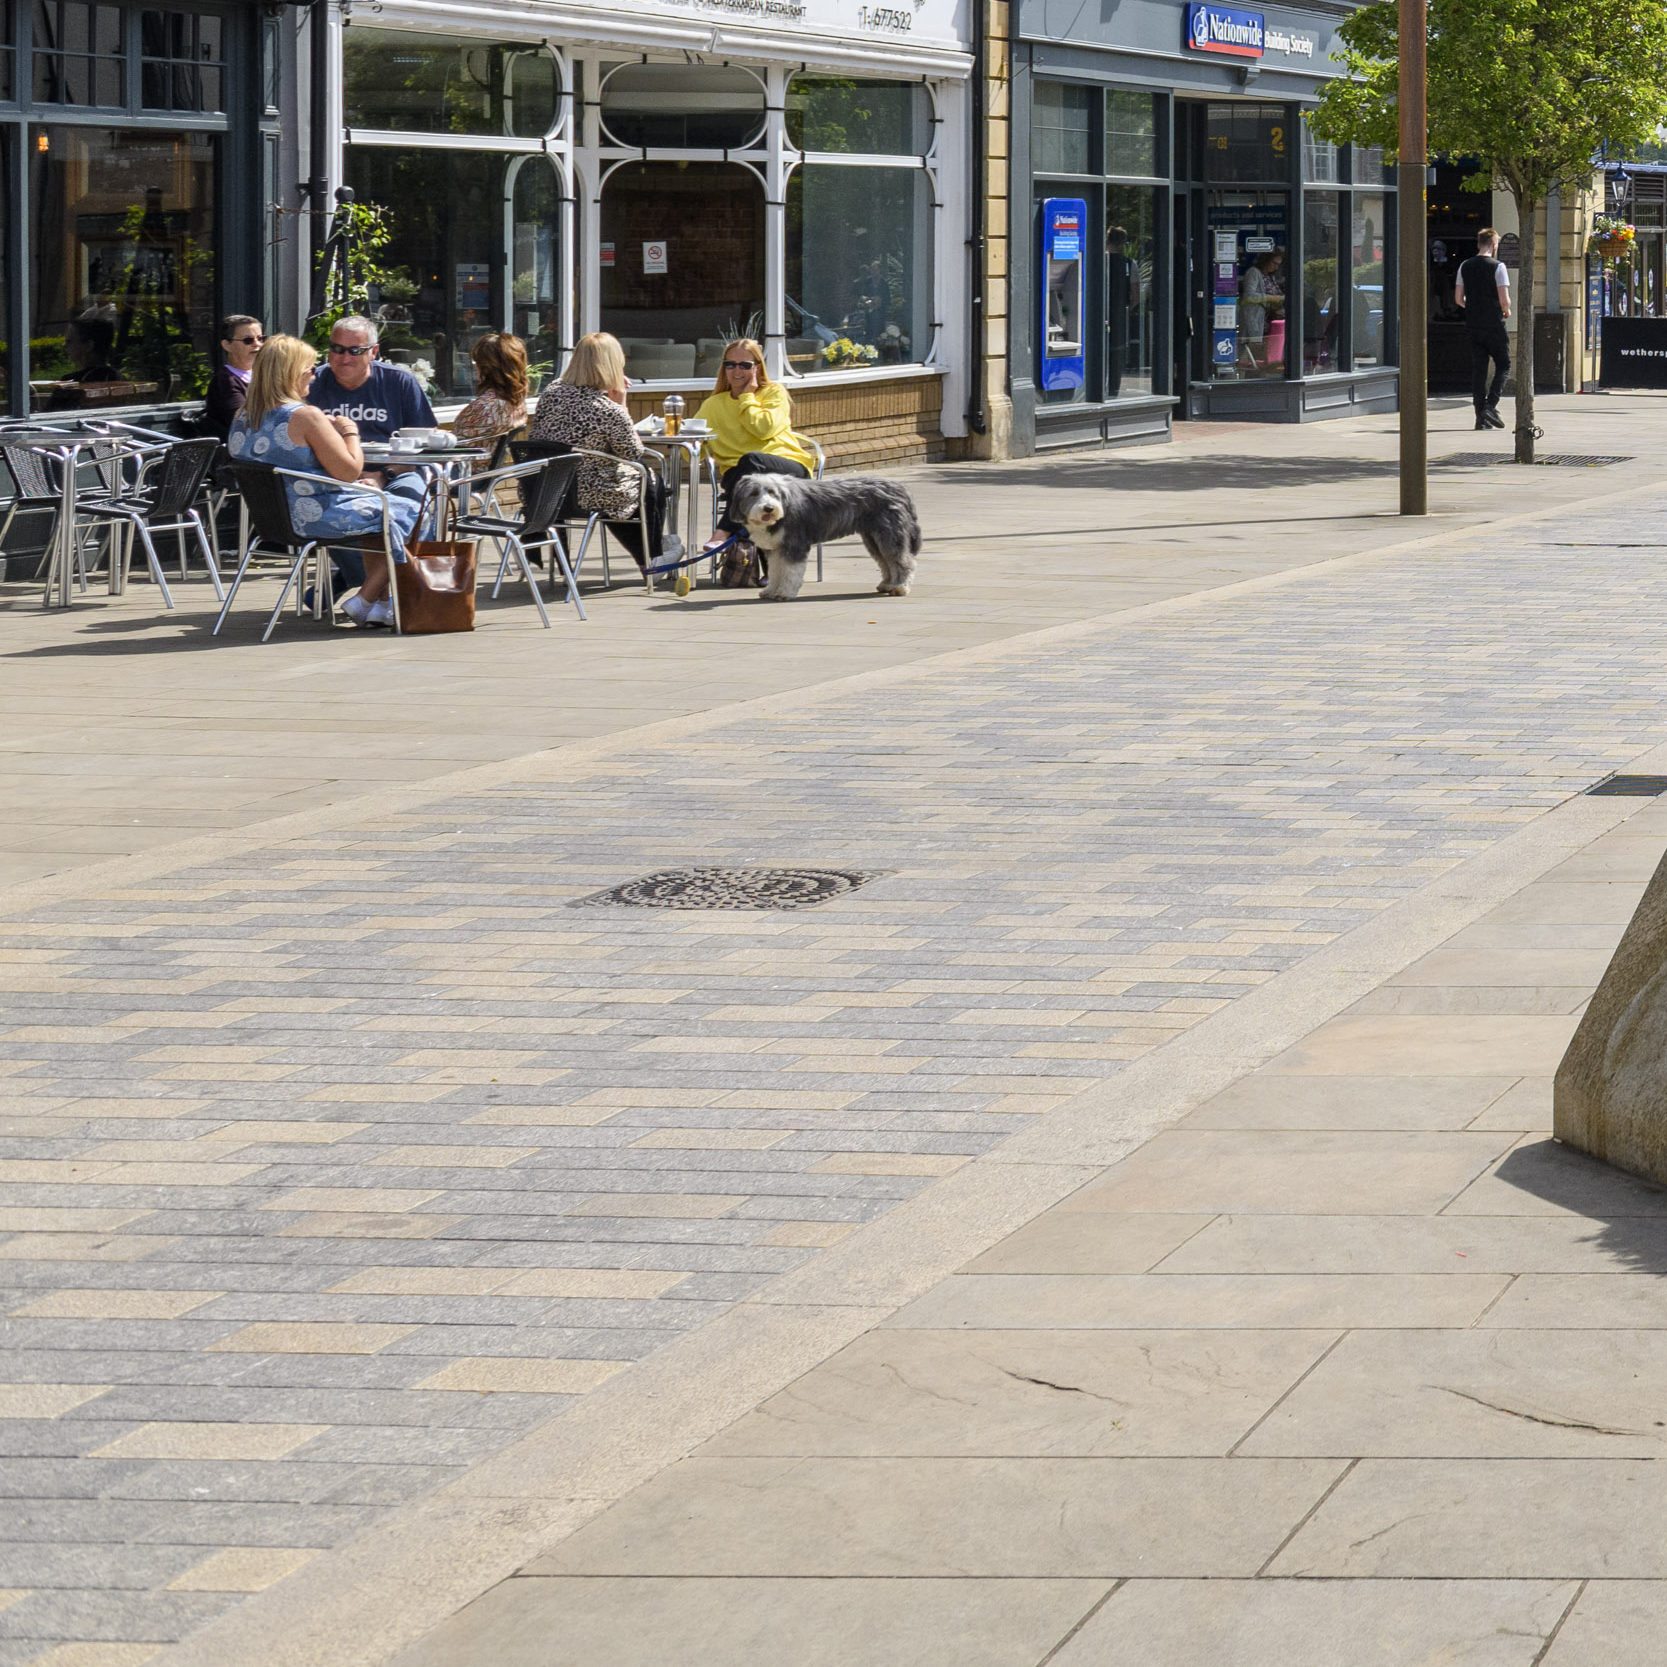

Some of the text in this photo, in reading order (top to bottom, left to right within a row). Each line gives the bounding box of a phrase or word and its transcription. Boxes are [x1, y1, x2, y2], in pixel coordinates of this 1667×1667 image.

[765, 1, 808, 18] RESTAURANT
[874, 8, 913, 31] 677522
[1210, 13, 1263, 47] Nationwide
[1264, 30, 1314, 58] Building Society
